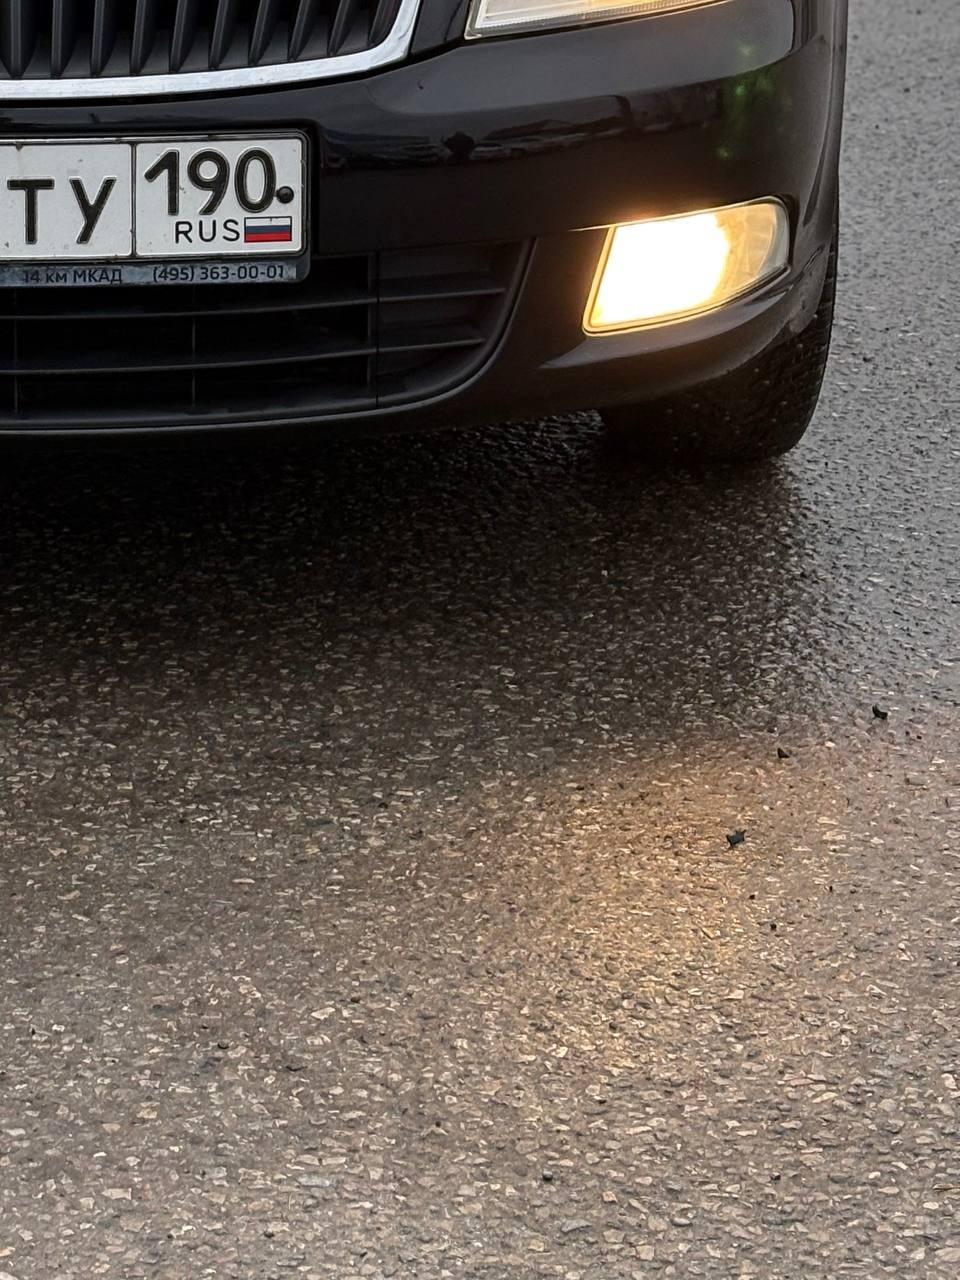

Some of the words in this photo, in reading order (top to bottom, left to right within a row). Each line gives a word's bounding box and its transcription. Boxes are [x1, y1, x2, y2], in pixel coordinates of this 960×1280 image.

[144, 147, 277, 216] 190
[175, 219, 240, 244] RUS
[46, 271, 67, 283] км
[73, 269, 123, 284] МКАД
[152, 265, 195, 282] (495)
[200, 264, 284, 281] 363-00-01
